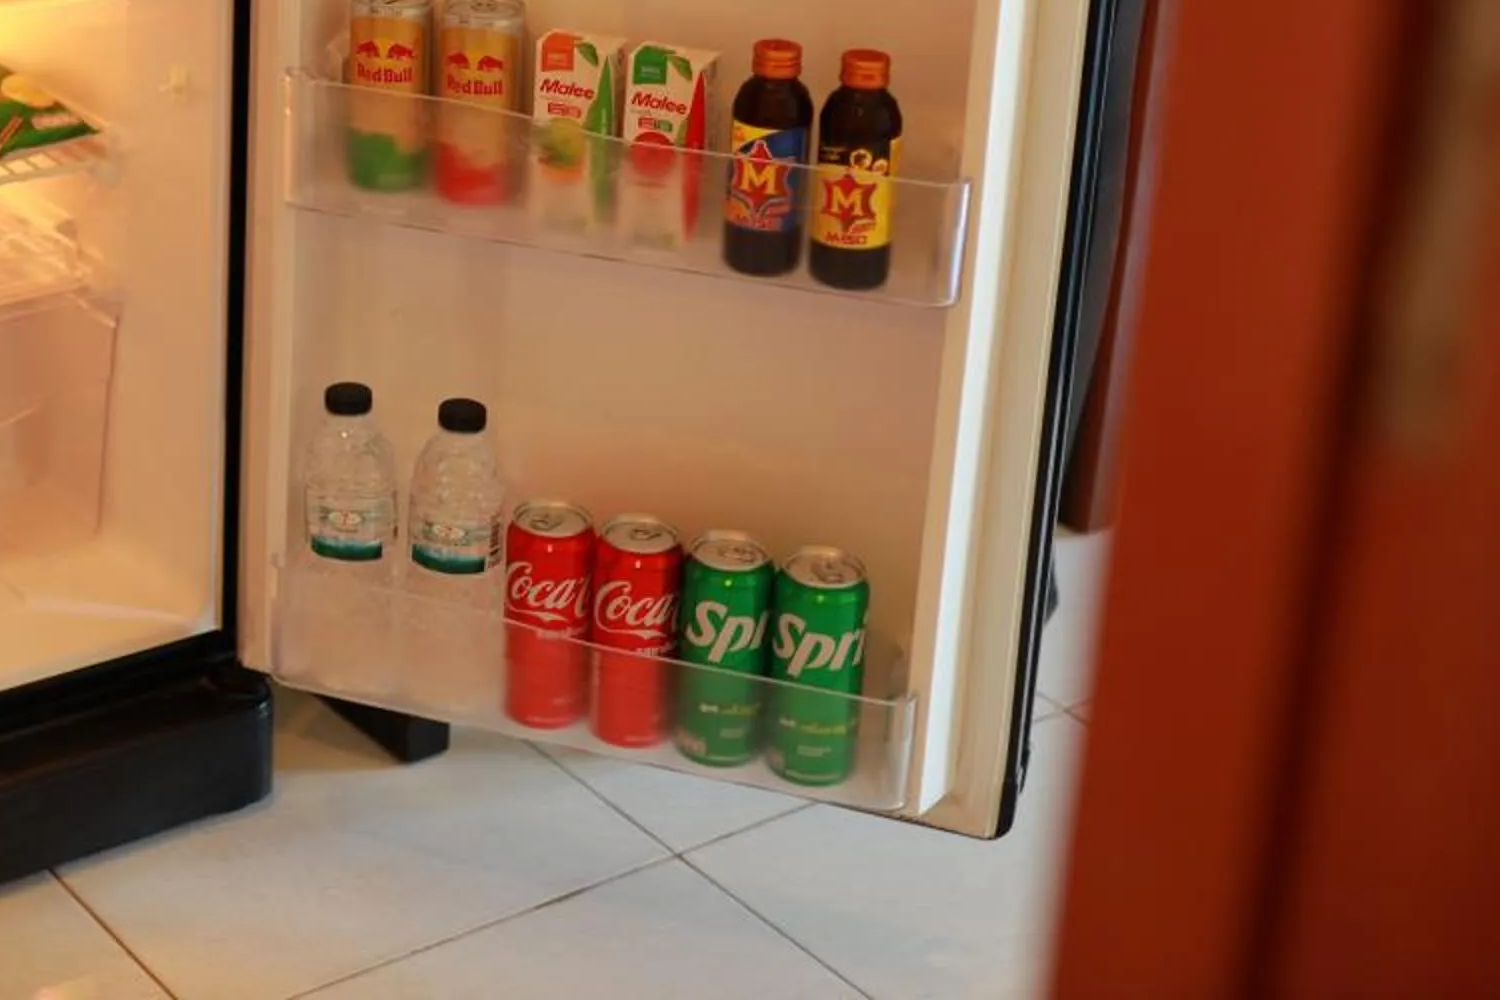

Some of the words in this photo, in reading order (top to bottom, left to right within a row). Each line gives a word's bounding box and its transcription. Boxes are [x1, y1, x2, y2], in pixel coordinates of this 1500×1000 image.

[356, 62, 382, 83] Red
[384, 67, 412, 84] Bull
[447, 74, 472, 95] Red
[474, 79, 504, 96] Bull
[540, 78, 595, 100] Malee
[631, 91, 688, 116] Malee
[740, 161, 778, 196] M
[830, 185, 864, 217] M
